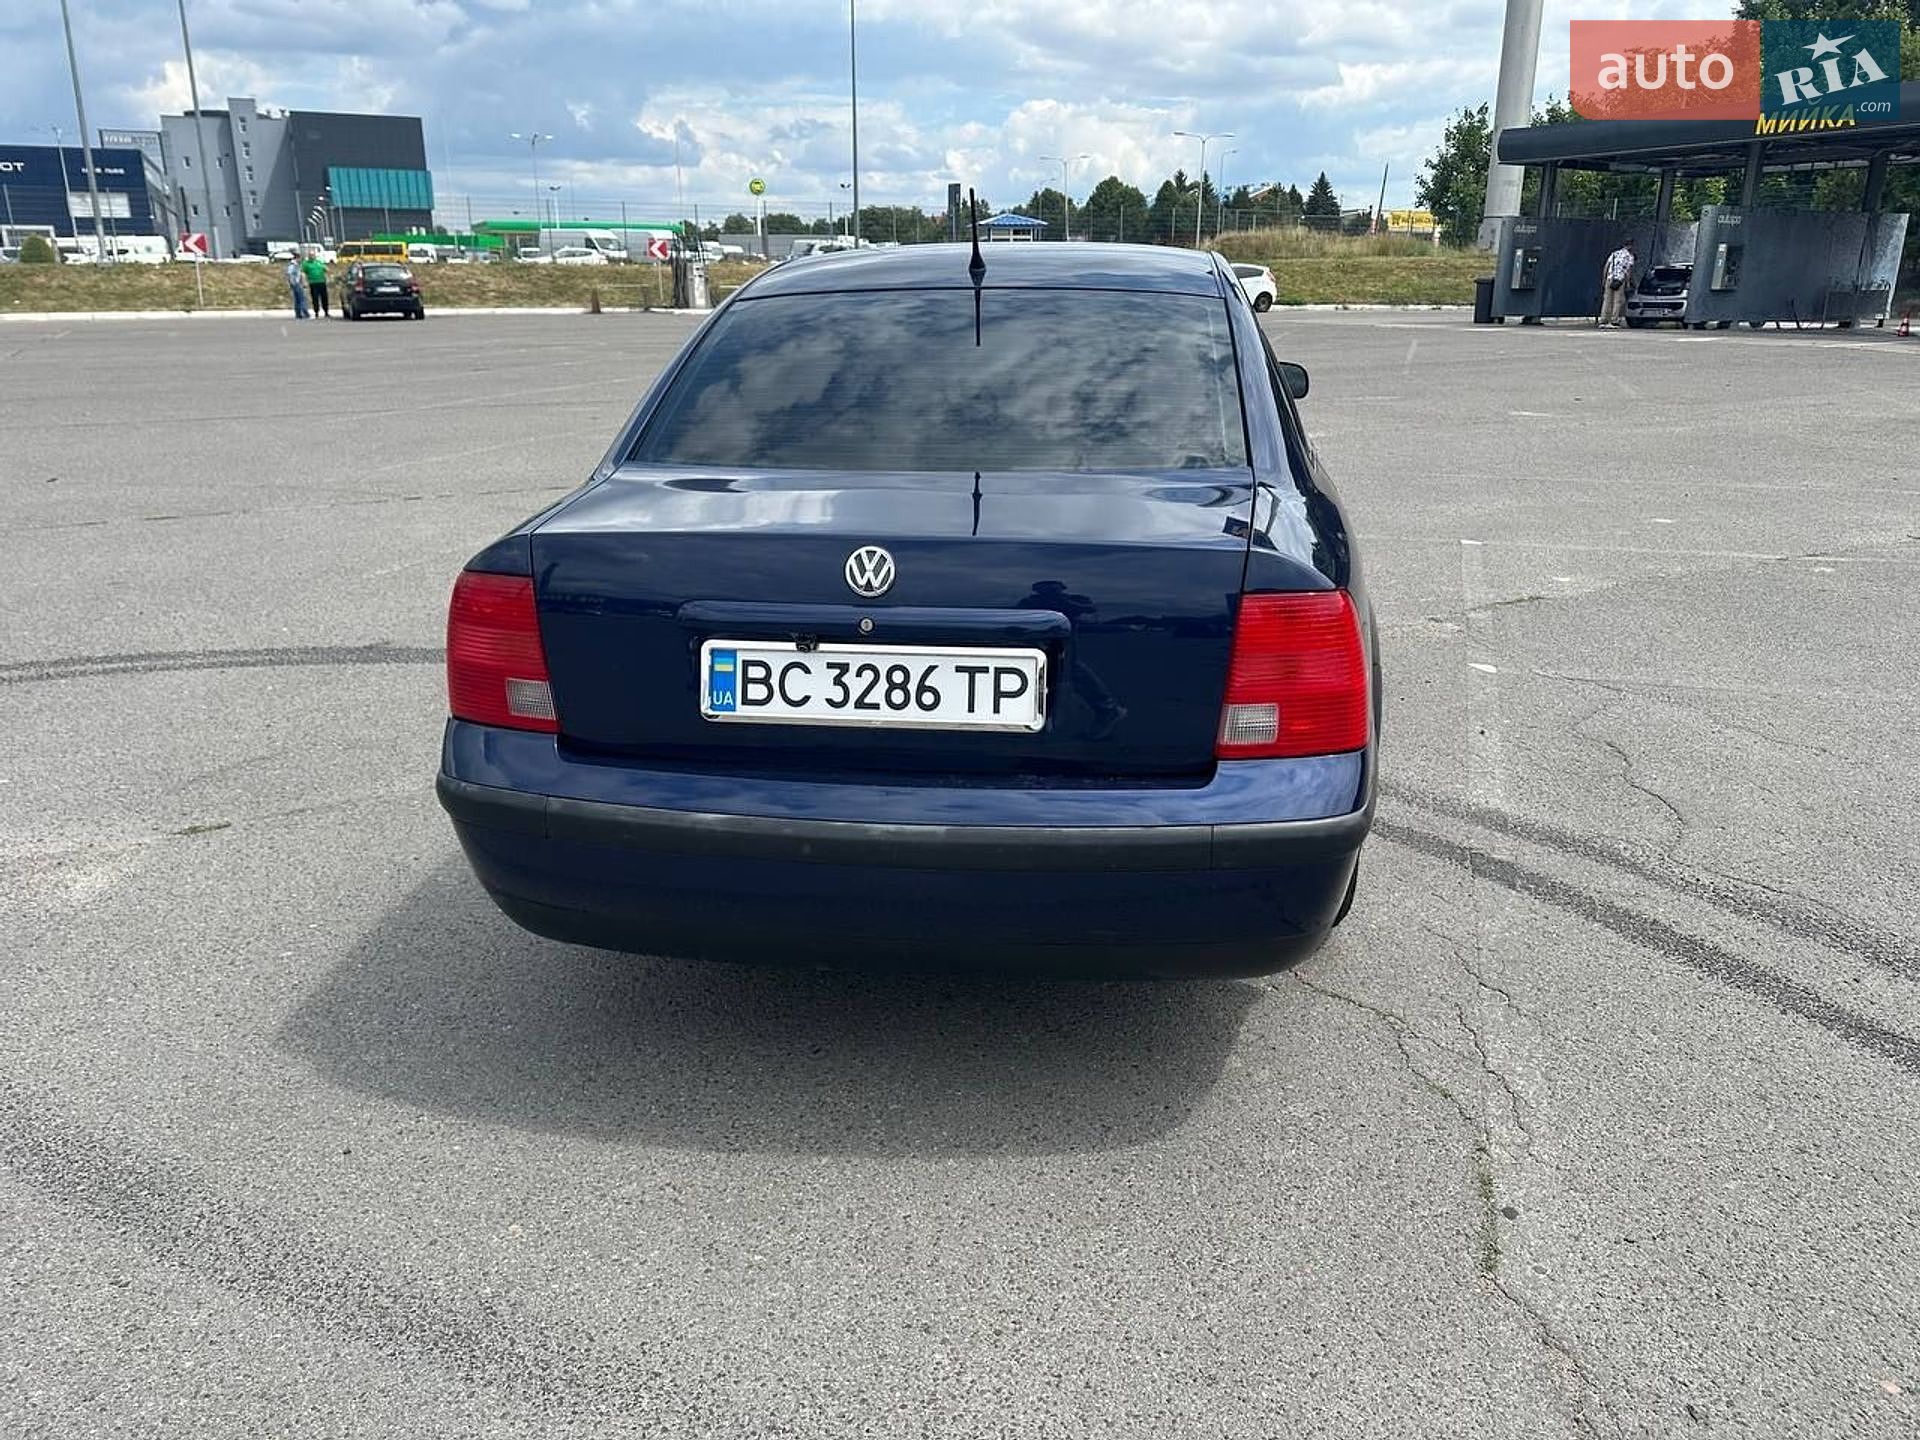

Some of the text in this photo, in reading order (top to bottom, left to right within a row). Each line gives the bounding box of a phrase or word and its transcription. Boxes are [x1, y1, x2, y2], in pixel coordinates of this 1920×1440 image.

[713, 690, 734, 706] UA
[741, 659, 1029, 714] BC 3286 TP
